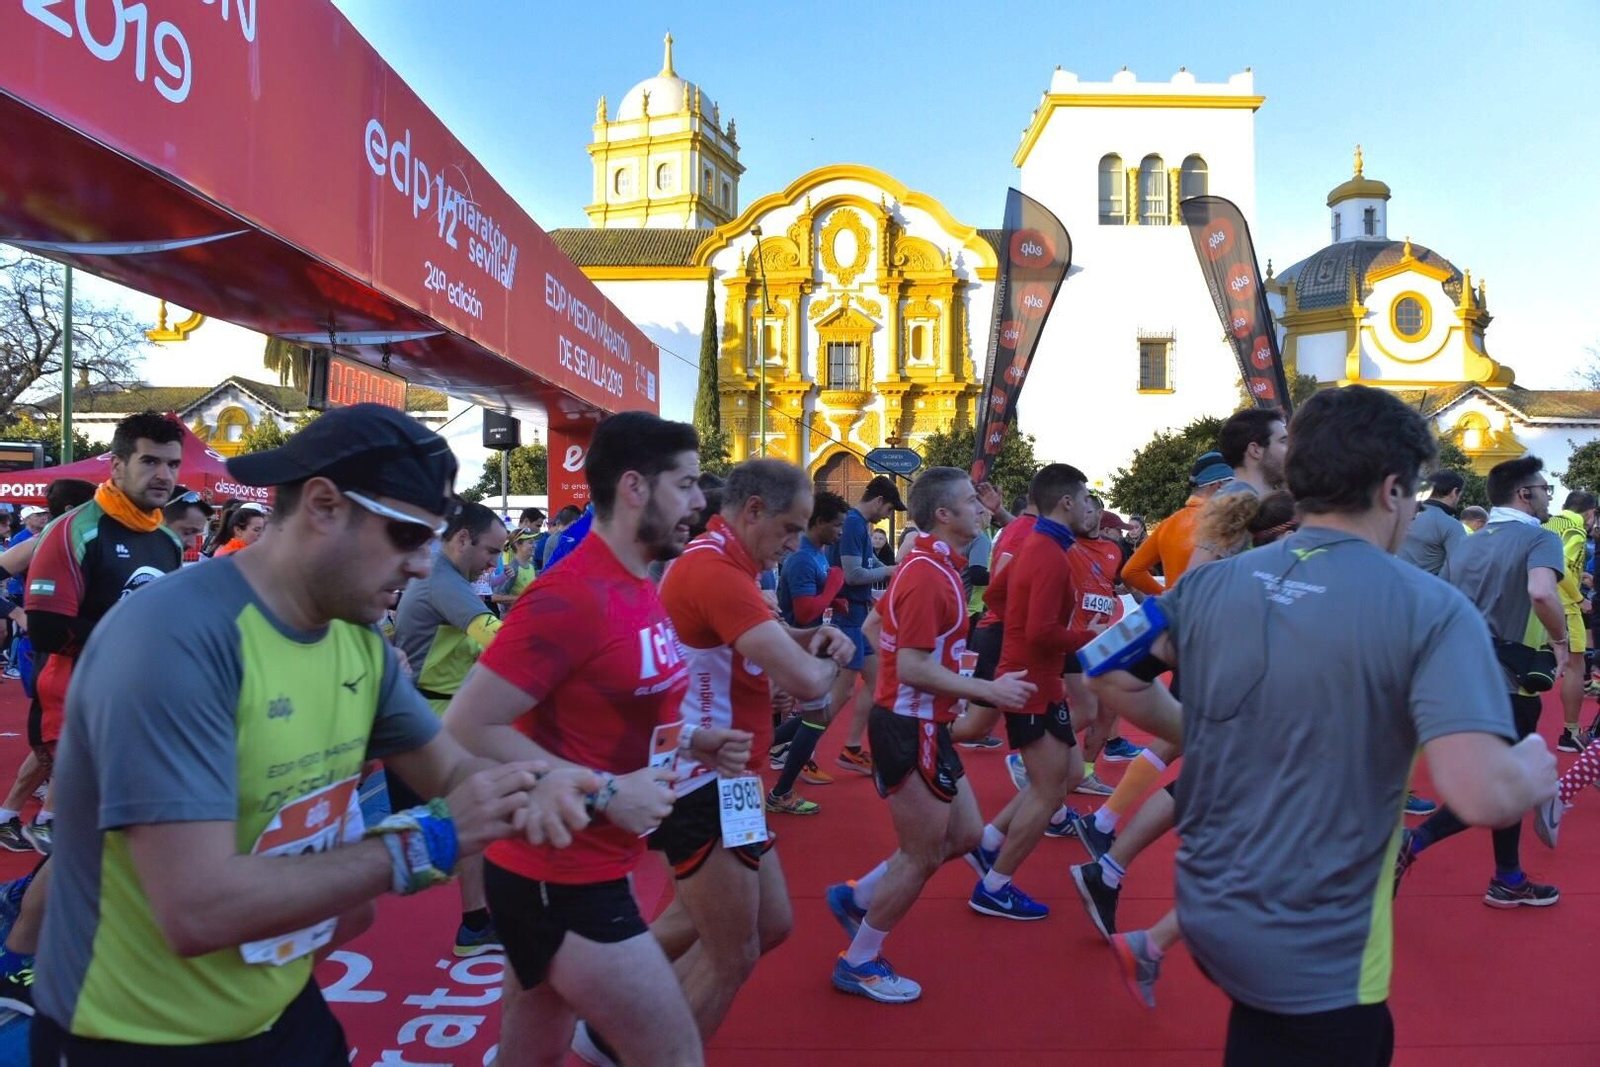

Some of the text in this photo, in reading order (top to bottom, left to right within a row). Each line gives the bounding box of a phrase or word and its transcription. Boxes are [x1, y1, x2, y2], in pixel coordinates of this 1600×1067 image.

[22, 0, 192, 103] 019
[365, 118, 429, 218] edp
[455, 192, 508, 260] maratón
[468, 236, 510, 290] sevilla
[447, 281, 483, 321] edición
[545, 271, 631, 365] EDP MEDIO MARATÓN
[559, 334, 573, 372] DE
[574, 345, 606, 388] SEVILLA
[606, 366, 623, 397] 2019
[0, 483, 47, 497] PORT
